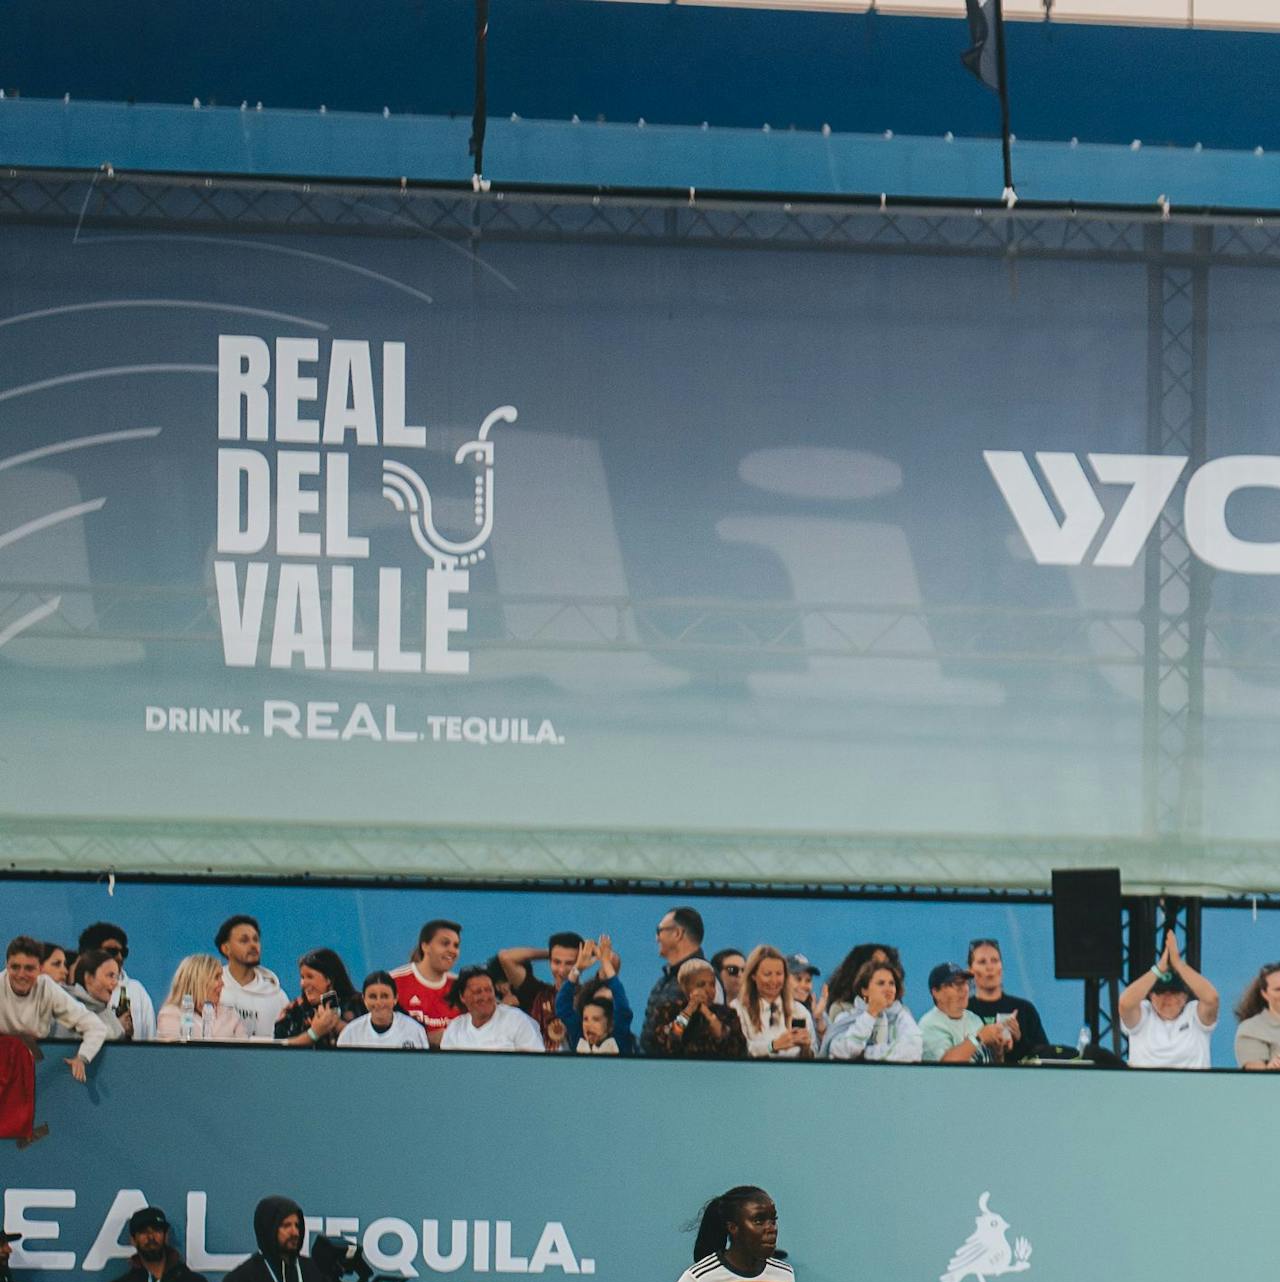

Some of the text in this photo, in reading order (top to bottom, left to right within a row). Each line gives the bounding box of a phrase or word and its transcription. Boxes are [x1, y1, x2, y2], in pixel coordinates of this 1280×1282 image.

[218, 334, 426, 447] REAL
[217, 448, 370, 557] DEL
[214, 561, 470, 674] VALLE
[145, 706, 250, 734] DRINK.
[427, 715, 565, 744] TEQUILA.
